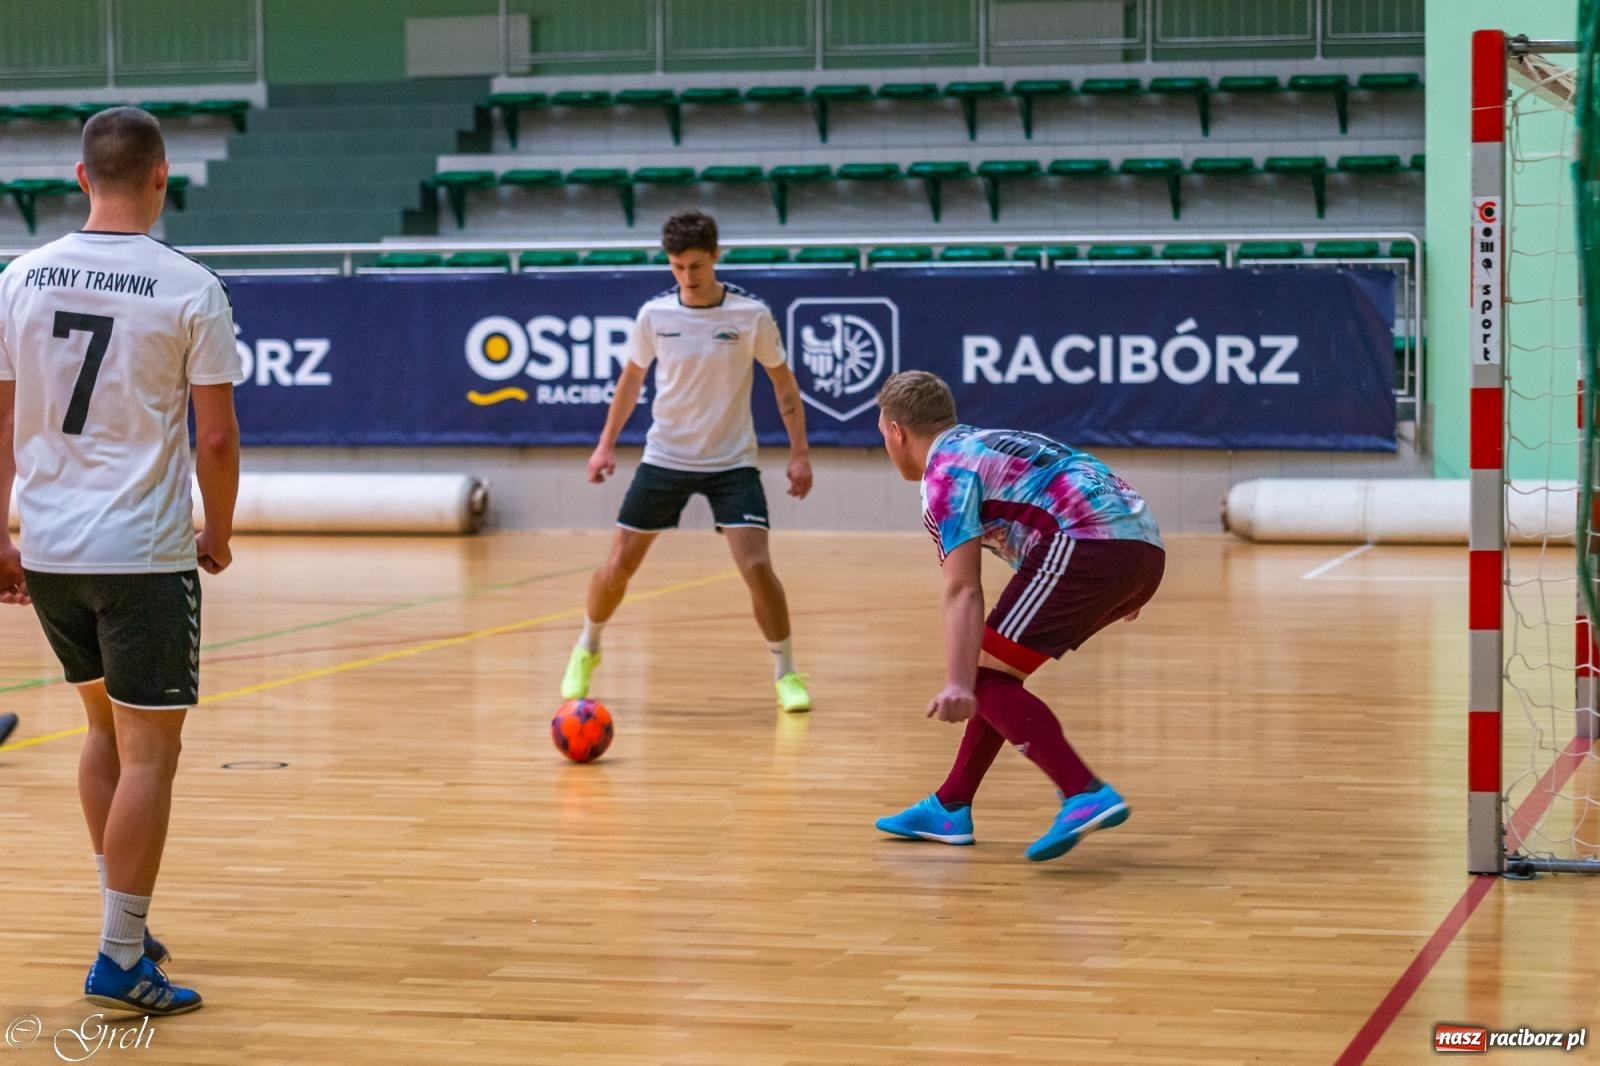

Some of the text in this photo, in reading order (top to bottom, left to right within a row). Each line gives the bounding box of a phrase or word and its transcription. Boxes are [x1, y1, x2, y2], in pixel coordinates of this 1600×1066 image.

[25, 267, 158, 298] PIĘKNY TRAWNIK
[962, 317, 1300, 385] RACIBÓRZ
[1481, 284, 1493, 361] sport
[52, 310, 115, 435] 7
[536, 380, 648, 404] RACIBÓZ
